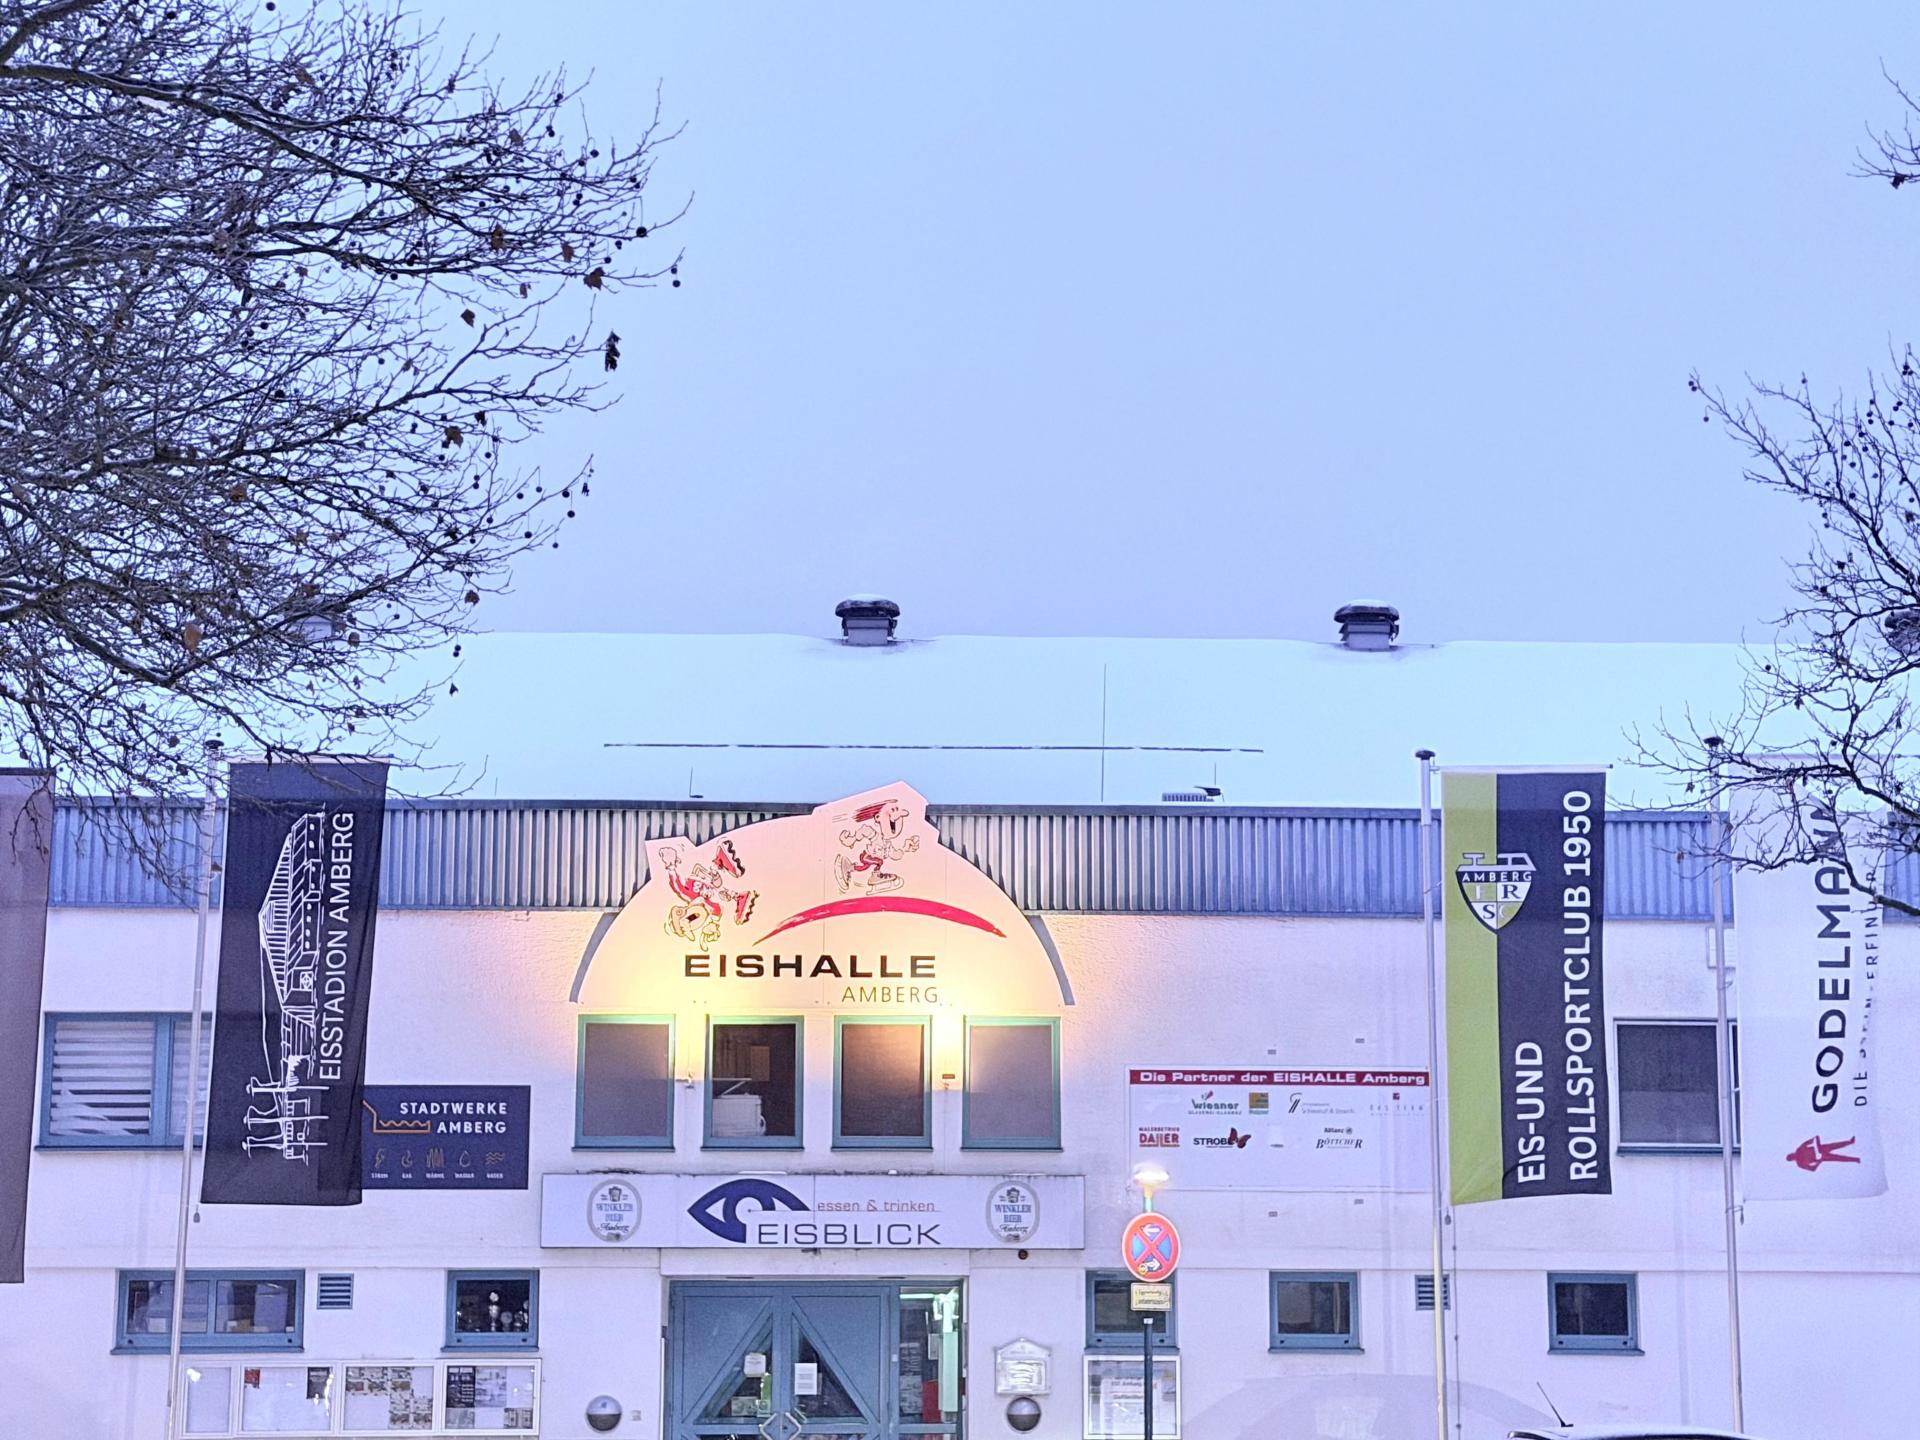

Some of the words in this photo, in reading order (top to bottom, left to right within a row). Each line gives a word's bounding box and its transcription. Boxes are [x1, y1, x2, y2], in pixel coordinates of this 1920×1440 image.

[1563, 790, 1592, 877] 1950
[329, 812, 354, 923] AMBERG
[1461, 871, 1533, 882] AMBERG
[684, 954, 936, 978] EISHALLE
[319, 931, 348, 1080] EISSTADION
[841, 986, 939, 1003] AMBERG
[1563, 885, 1598, 1181] ROLLSPORTCLUB
[1139, 1071, 1166, 1082] Die
[1172, 1072, 1235, 1082] Partner
[1240, 1072, 1267, 1082] der
[1273, 1072, 1356, 1083] EISHALLE
[1362, 1074, 1425, 1085] Amberg
[1852, 1071, 1868, 1107] DIE
[400, 1102, 508, 1115] STADTWERKE
[1515, 1041, 1546, 1183] EIS-UND
[437, 1121, 507, 1134] AMBERG
[817, 1202, 860, 1212] essen
[866, 1199, 878, 1212] &
[883, 1199, 936, 1212] trinken
[994, 1204, 1032, 1213] WINKLER
[757, 1223, 942, 1245] EISBLICK
